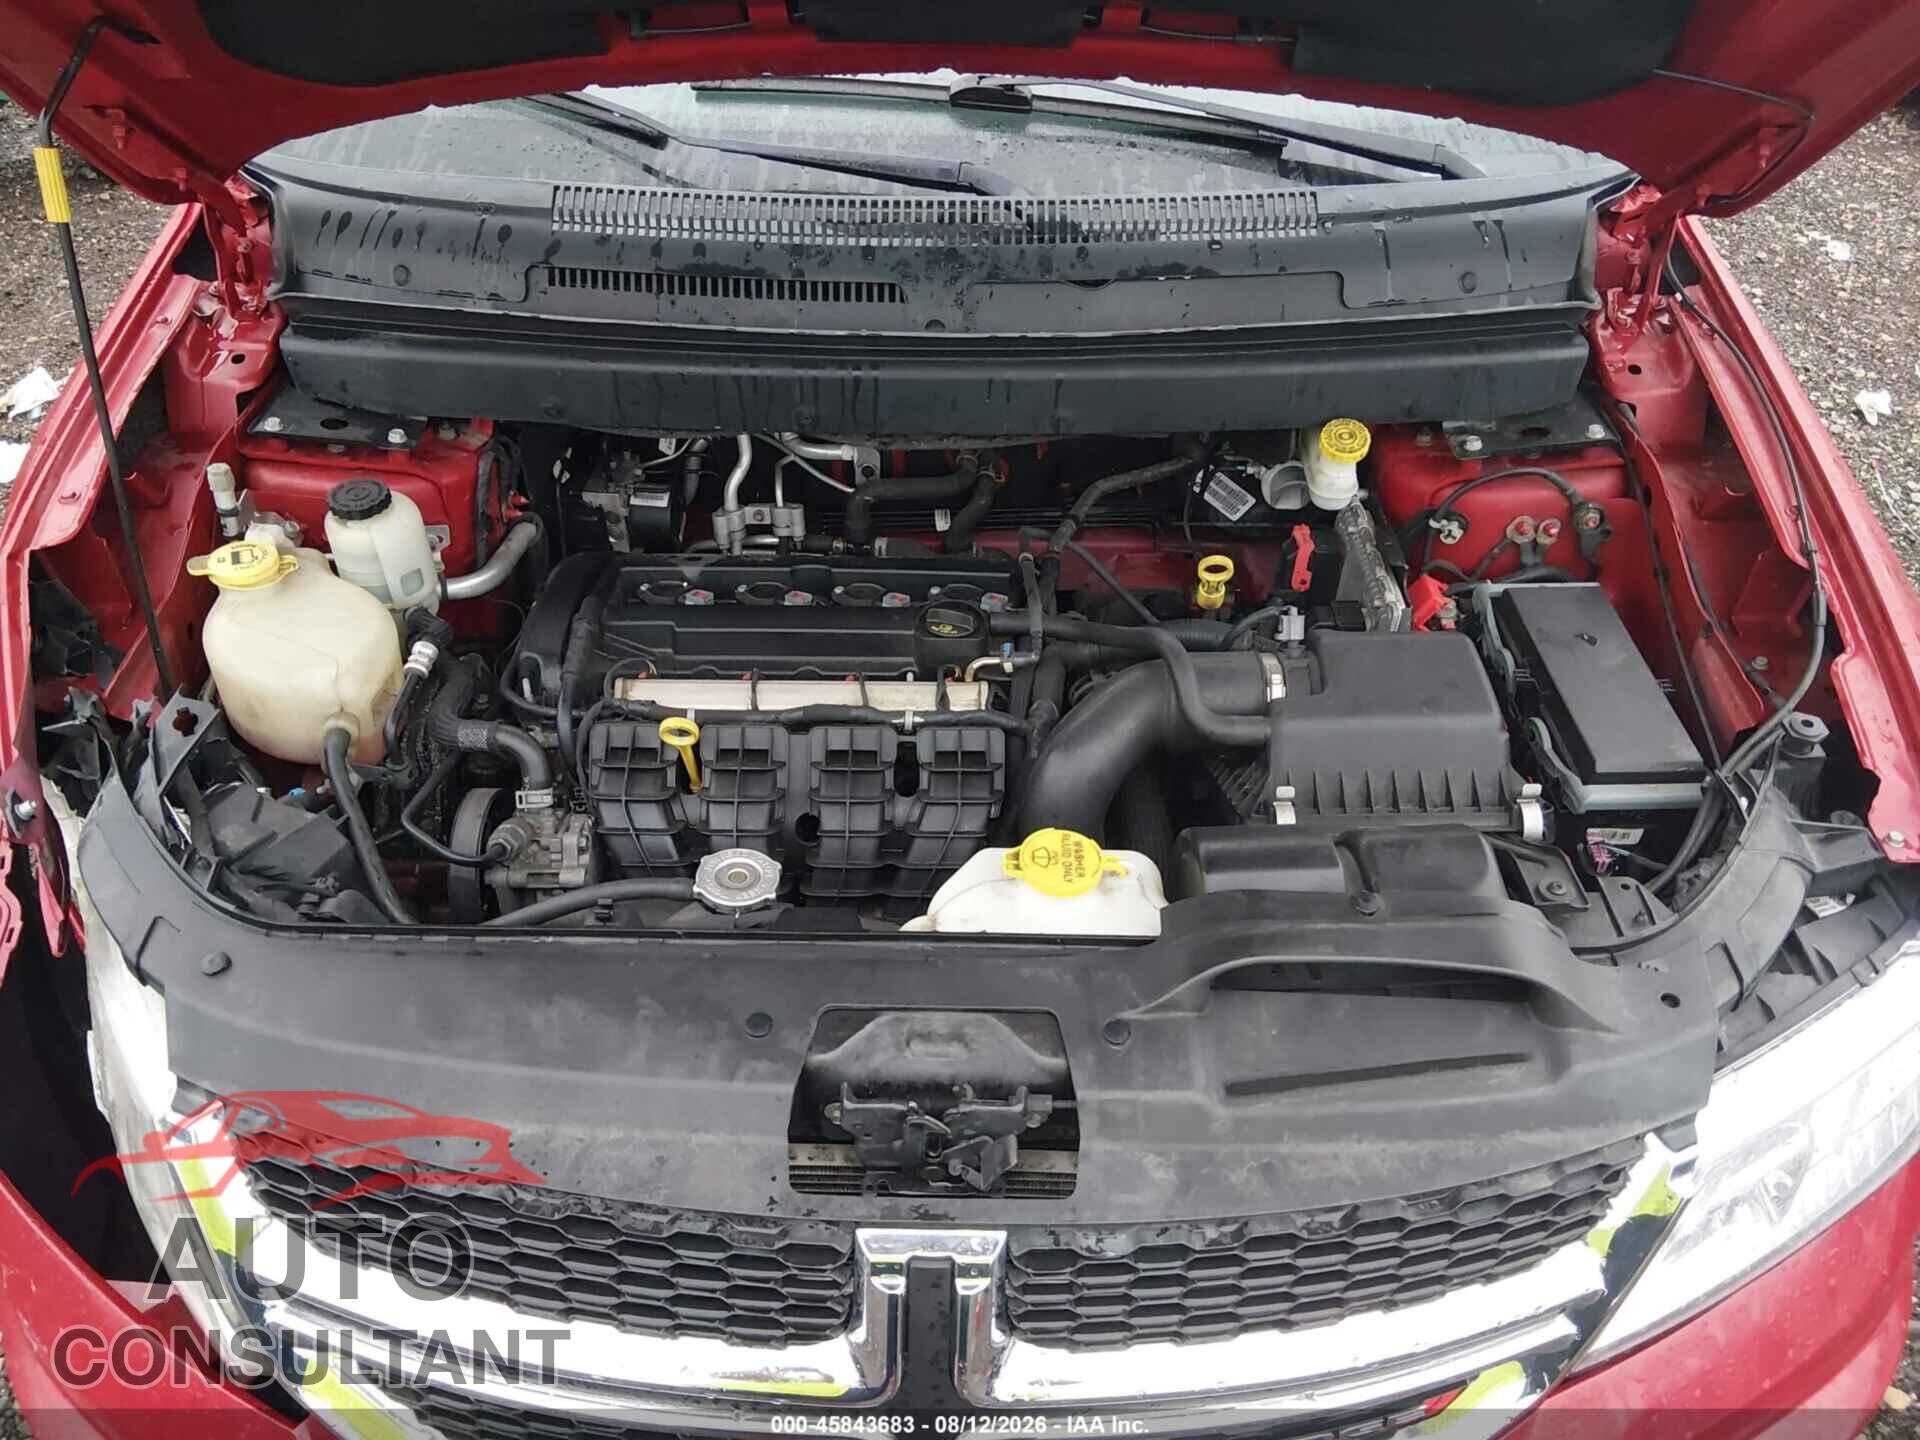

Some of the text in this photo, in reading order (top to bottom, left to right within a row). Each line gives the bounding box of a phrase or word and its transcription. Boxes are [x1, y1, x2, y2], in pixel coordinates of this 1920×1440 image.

[1061, 833, 1073, 883] FLUID ONLY
[1072, 840, 1086, 878] WASHER
